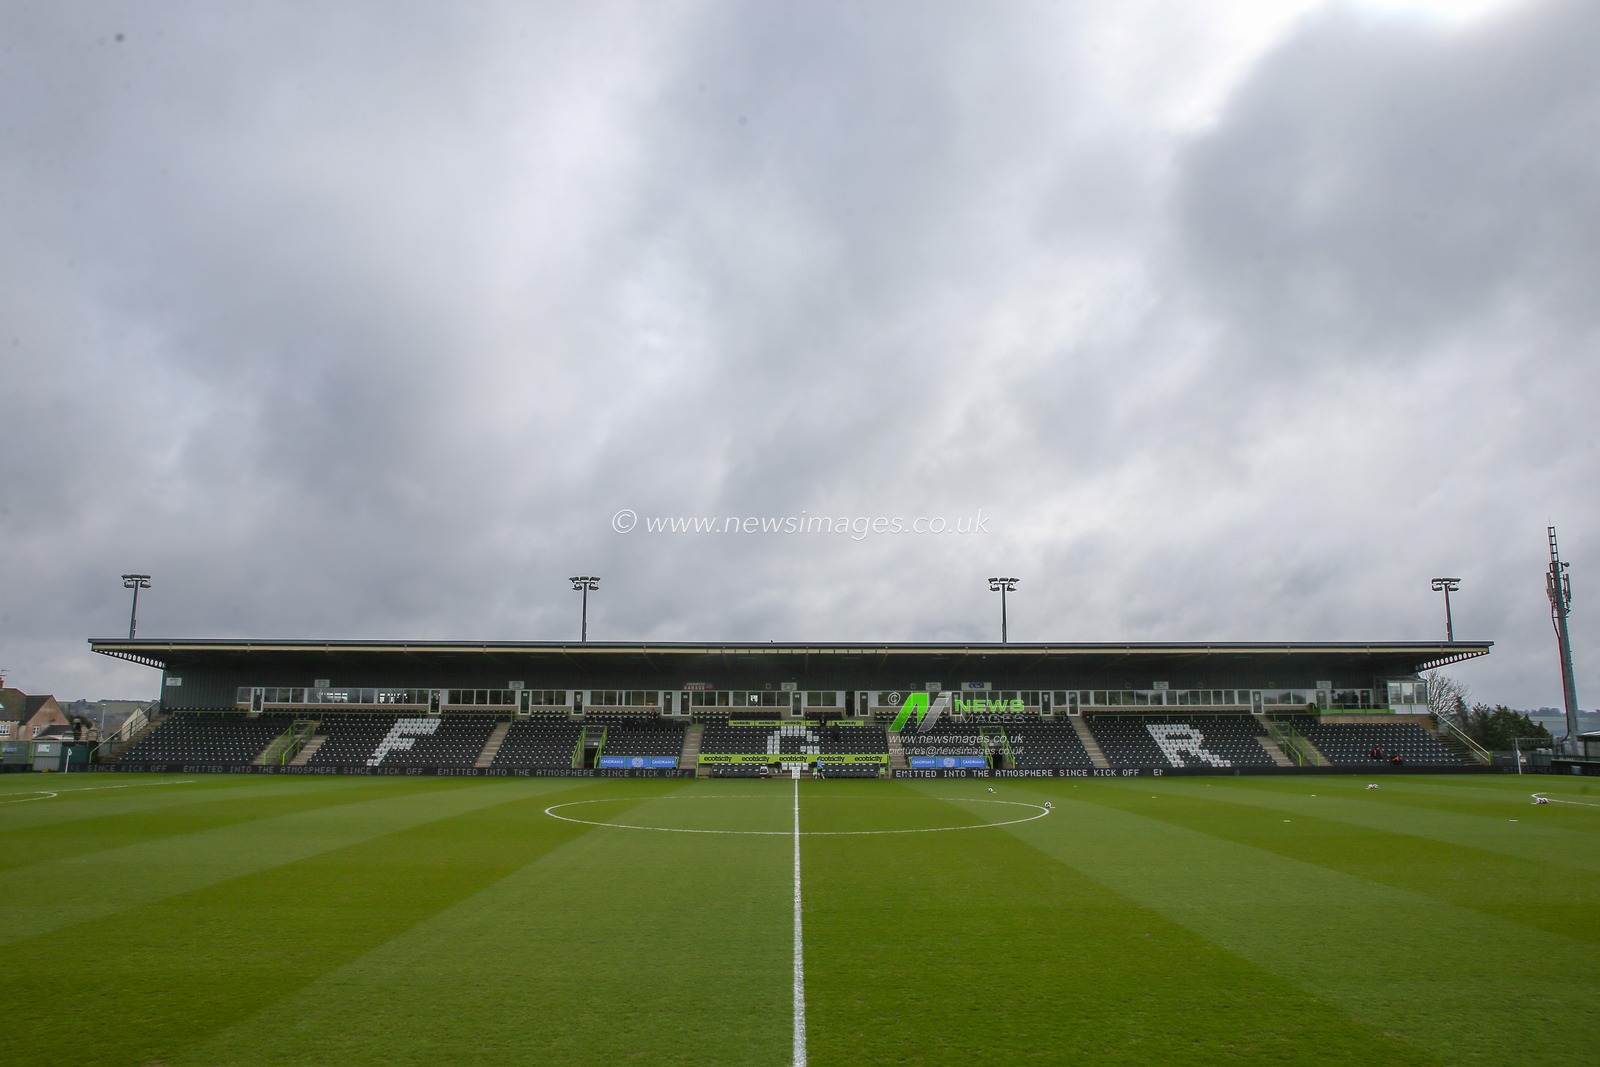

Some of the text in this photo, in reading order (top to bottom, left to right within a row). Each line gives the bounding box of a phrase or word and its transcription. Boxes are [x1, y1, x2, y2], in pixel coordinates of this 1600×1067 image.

[704, 755, 732, 763] ecotricity
[741, 755, 770, 763] ecotricity
[779, 755, 808, 763] ecotricity
[854, 755, 883, 763] ecotricity
[183, 765, 223, 773] EMITTED
[229, 765, 252, 773] INTO
[280, 766, 337, 774] ATMOSPHERE
[377, 767, 400, 775] KICK
[406, 767, 424, 775] OFF
[437, 768, 478, 776] EMITTED
[485, 768, 507, 776] INTO
[513, 768, 530, 776] THE
[601, 769, 629, 777] SINCE
[635, 769, 659, 777] KICK
[995, 769, 1053, 777] ATMOSPHERE
[1059, 769, 1088, 777] SINCE
[1093, 769, 1117, 777] KICK
[1122, 769, 1140, 777] OFF
